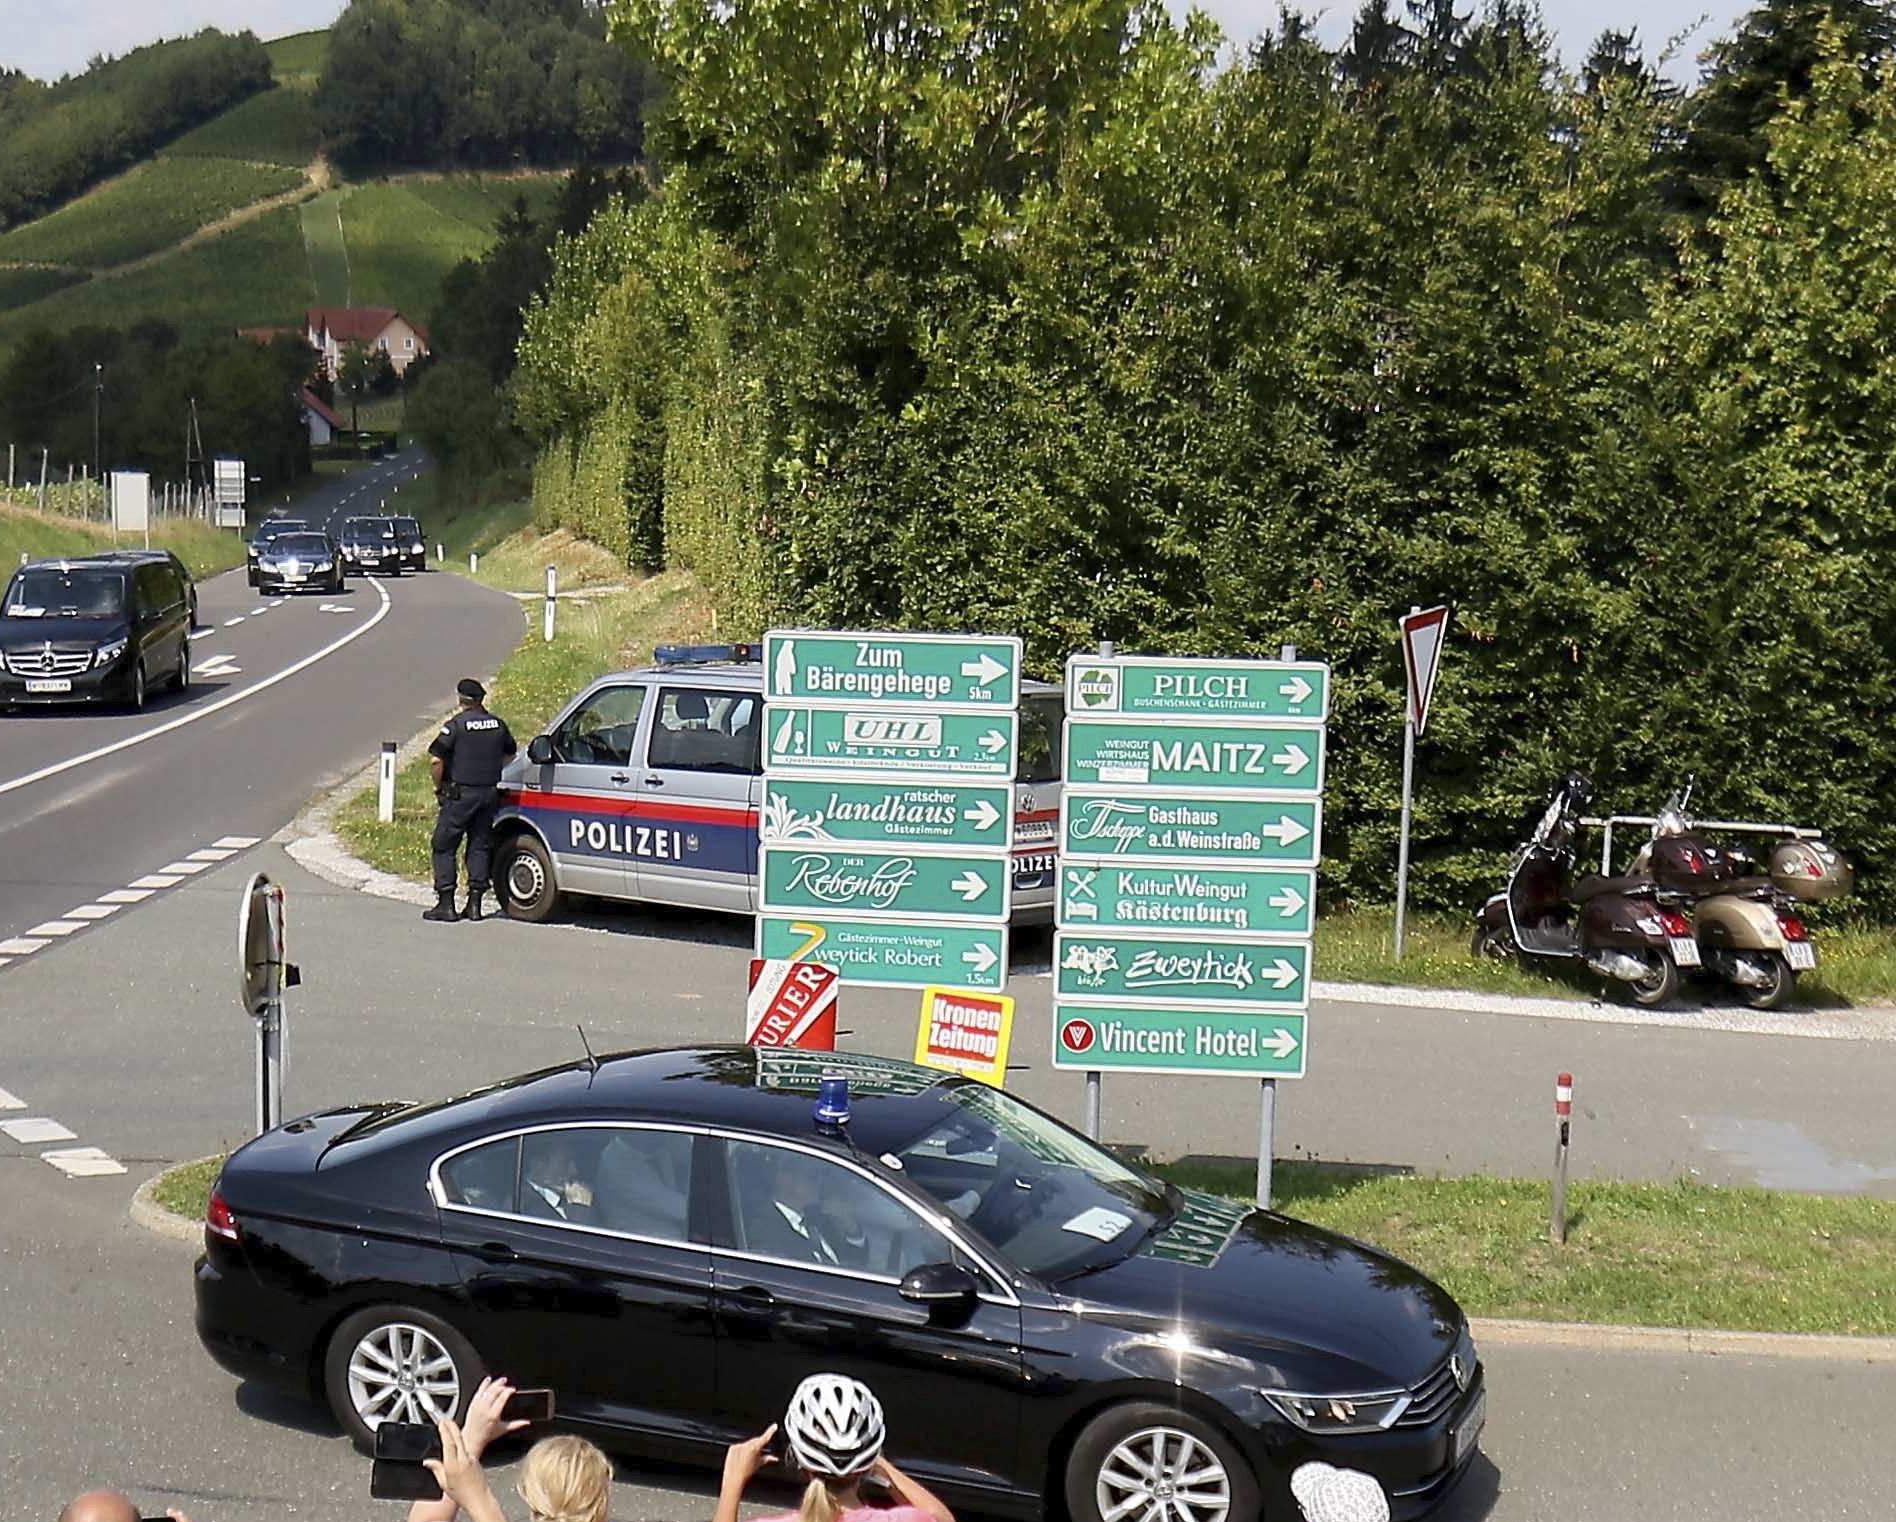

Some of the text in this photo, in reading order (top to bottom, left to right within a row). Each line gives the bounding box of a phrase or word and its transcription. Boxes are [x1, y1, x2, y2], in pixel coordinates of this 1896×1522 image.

[856, 643, 902, 667] Zum
[807, 666, 951, 699] Bärengehege
[1153, 674, 1248, 698] PILCH
[969, 687, 992, 700] 5km
[466, 719, 499, 731] POLIZEI
[854, 720, 933, 741] UHL
[826, 742, 959, 759] WEINGUT
[1096, 750, 1149, 760] WIRTSHAUS
[1104, 740, 1149, 749] WEINGUT
[1152, 741, 1265, 774] MAITZ
[904, 790, 956, 804] ratscher
[826, 793, 956, 824] landhaus
[1149, 806, 1218, 826] Gasthaus
[569, 818, 682, 860] POLIZEI
[885, 824, 954, 836] Gästezimmer
[843, 858, 864, 867] DER
[785, 854, 917, 909] Rebenhof
[838, 932, 943, 948] Gästezimmer-Weingut
[885, 948, 942, 967] Robert
[1125, 950, 1254, 985] Zweytick
[966, 972, 994, 985] 1.5km
[754, 965, 829, 1046] URIER
[933, 998, 1002, 1031] Kronen
[929, 1022, 998, 1057] Zeitung
[1100, 1021, 1258, 1057] Vincent Hotel
